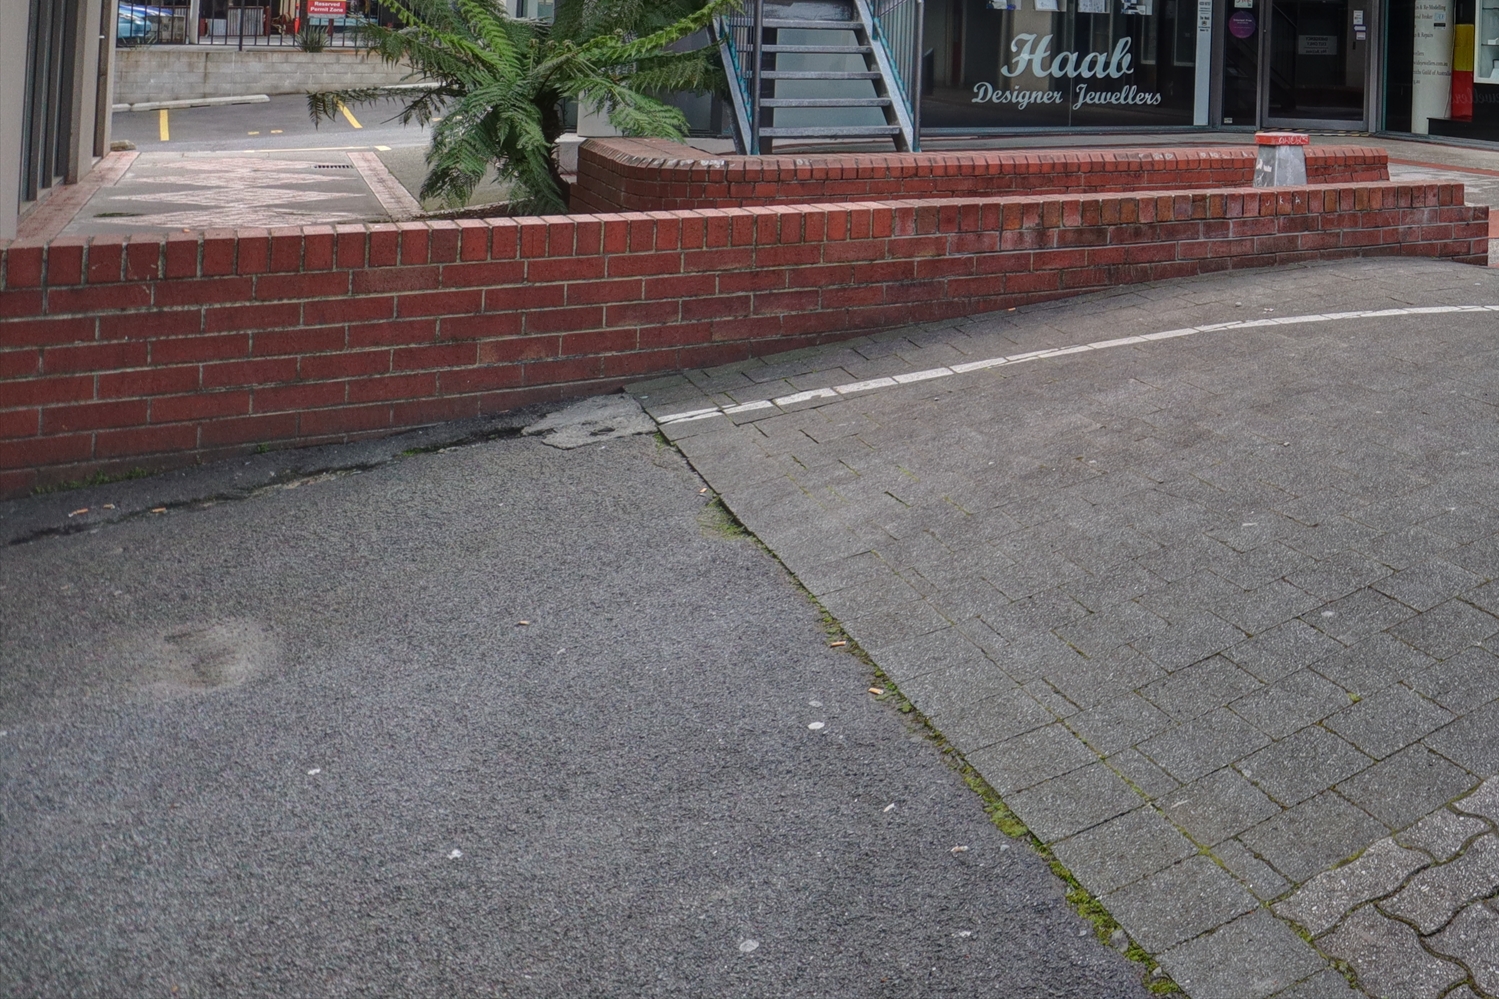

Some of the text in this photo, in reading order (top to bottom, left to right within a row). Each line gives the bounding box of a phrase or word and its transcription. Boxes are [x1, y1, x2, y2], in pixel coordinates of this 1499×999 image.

[1000, 33, 1135, 79] Haab
[972, 82, 1162, 111] Designer Jewellers
